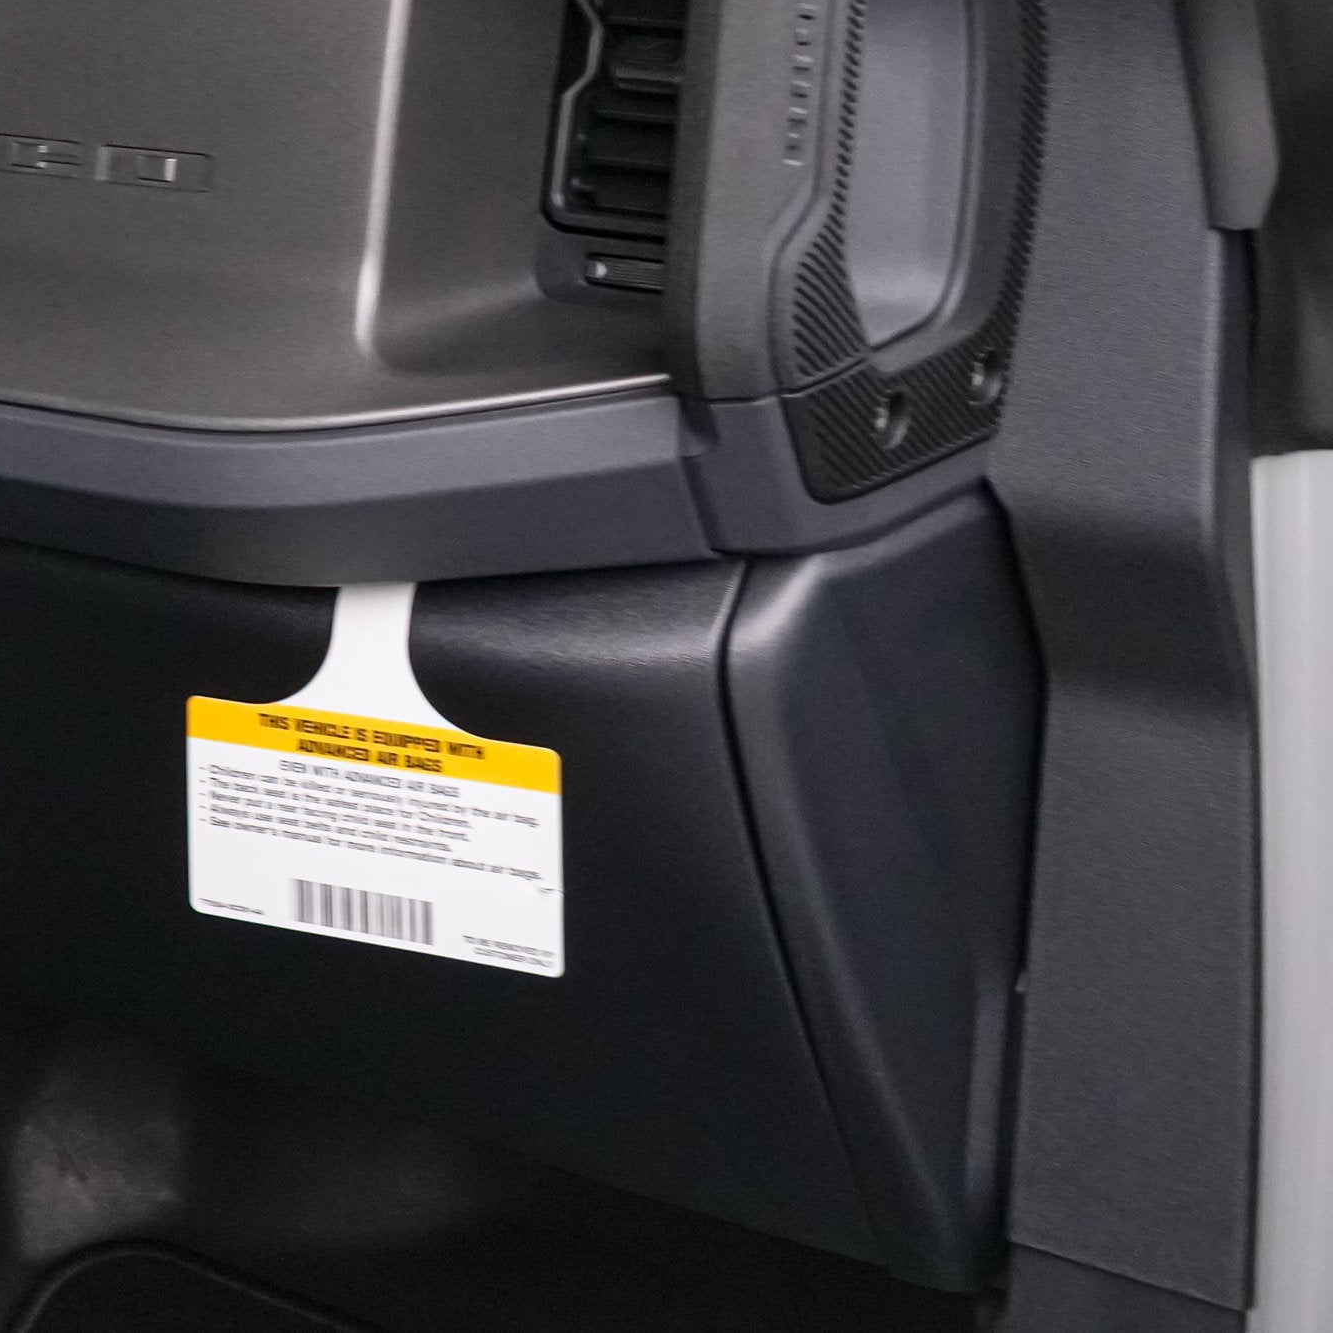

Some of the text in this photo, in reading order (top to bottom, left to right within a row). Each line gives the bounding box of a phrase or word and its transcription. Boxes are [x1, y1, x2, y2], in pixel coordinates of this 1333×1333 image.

[259, 712, 288, 729] THIS
[296, 718, 349, 738] VEHICLE
[373, 730, 439, 752] EQUIPPED
[447, 741, 484, 759] WITH
[297, 738, 442, 772] ADVANCED AIR BAGS
